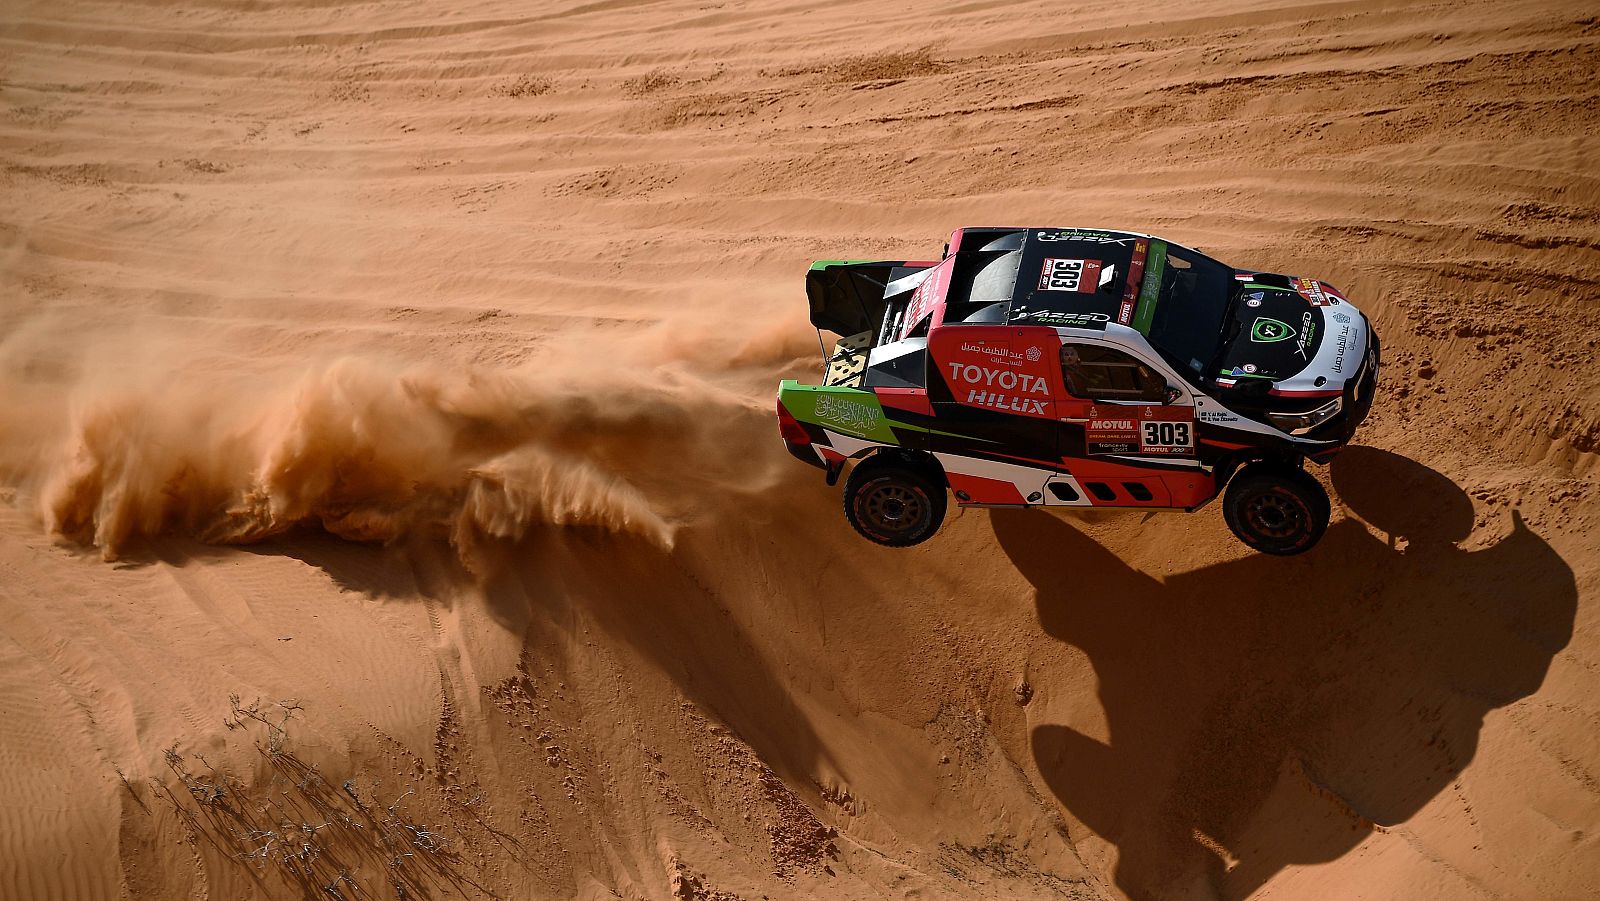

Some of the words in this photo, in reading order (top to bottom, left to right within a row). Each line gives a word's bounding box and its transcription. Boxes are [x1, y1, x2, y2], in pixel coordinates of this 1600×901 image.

[1050, 261, 1082, 289] 303
[1037, 317, 1088, 325] RACING
[1306, 322, 1316, 347] RACING
[961, 342, 981, 353] جميل
[981, 345, 1009, 357] اللطيف
[1009, 350, 1024, 360] عبد
[948, 362, 1049, 396] TOYOTA
[967, 389, 1049, 415] HILUX
[1090, 420, 1133, 430] MOTUL
[1144, 422, 1190, 446] 303
